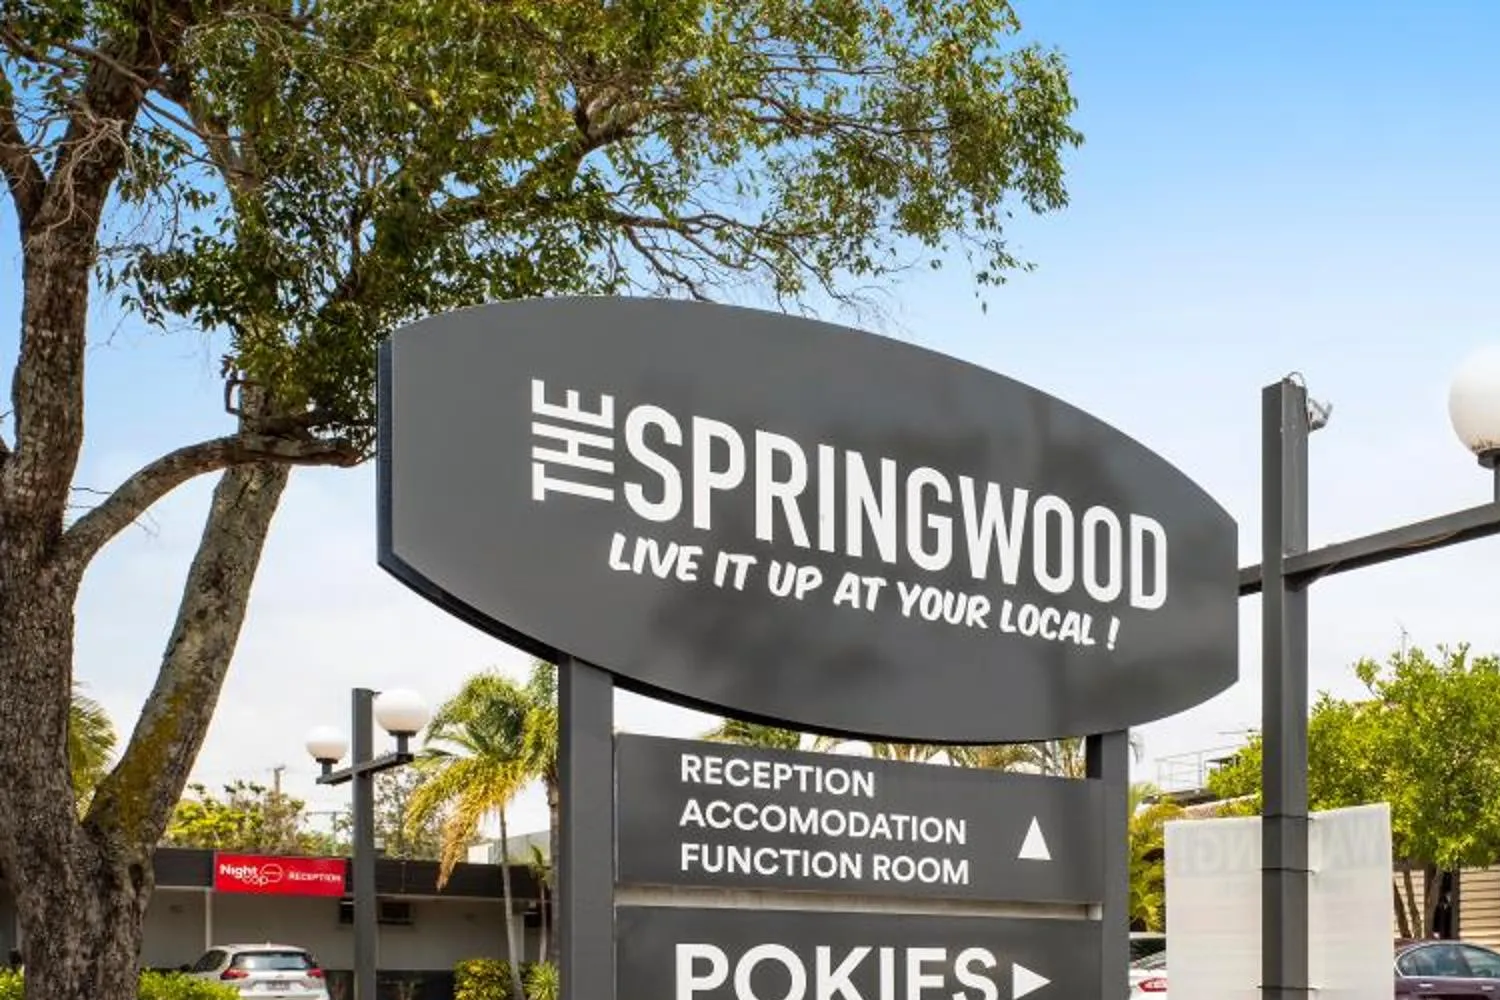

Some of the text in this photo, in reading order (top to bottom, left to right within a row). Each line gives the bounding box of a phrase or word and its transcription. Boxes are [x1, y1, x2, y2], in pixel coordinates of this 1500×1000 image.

[531, 378, 615, 502] THE
[622, 404, 1169, 610] SPRINGWOOD
[608, 533, 699, 582] LIVE
[714, 551, 758, 591] IT
[767, 559, 823, 601] UP
[832, 571, 888, 612] AT
[897, 580, 990, 630] YOUR
[999, 599, 1096, 647] LOCAL
[681, 752, 875, 798] RECEPTION
[679, 798, 967, 845] ACCOMODATION
[219, 863, 258, 879] Night
[681, 843, 969, 885] FUNCTION ROOM
